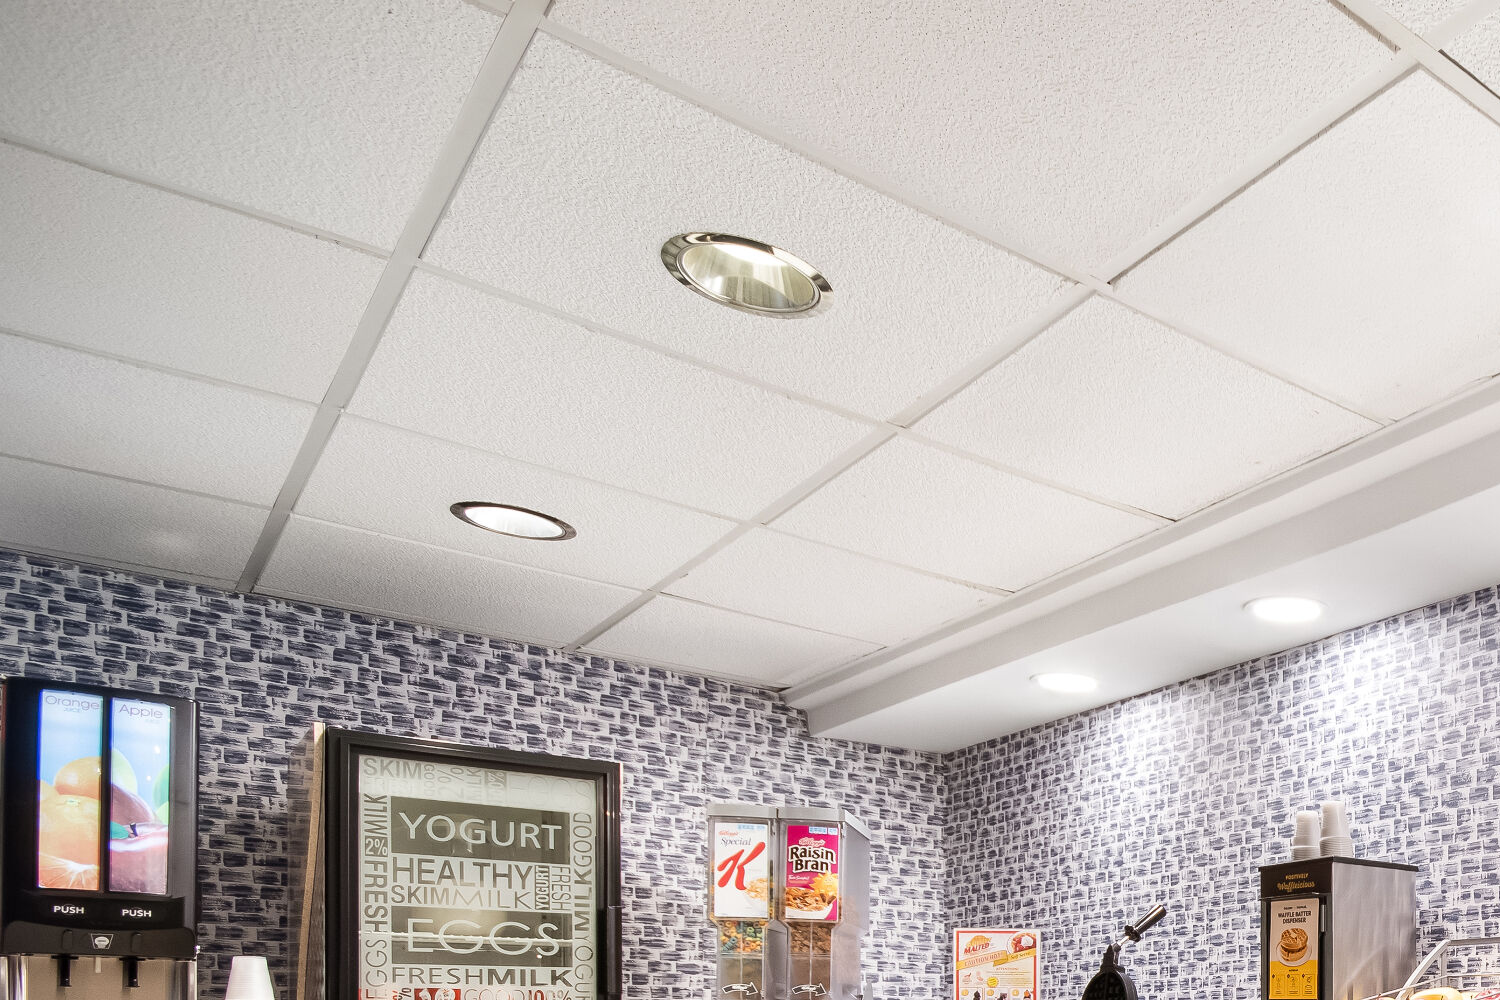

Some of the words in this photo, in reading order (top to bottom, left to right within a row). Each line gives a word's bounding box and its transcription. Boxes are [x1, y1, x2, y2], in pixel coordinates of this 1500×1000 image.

[45, 695, 100, 711] Orange
[120, 703, 163, 719] Apple
[363, 758, 422, 780] SKIM
[364, 793, 388, 835] MILK
[398, 812, 562, 850] YOGURT
[573, 812, 592, 867] GOOD
[721, 837, 752, 847] Special
[365, 837, 388, 856] 2%
[789, 846, 835, 861] Raisin
[392, 856, 533, 890] HEALTHY
[717, 841, 766, 891] K
[795, 860, 829, 872] Bran
[364, 860, 388, 933] FRESH
[535, 865, 550, 910] YOGURT
[552, 867, 571, 910] FRESH
[574, 868, 592, 931] MILK
[53, 905, 84, 914] PUSH
[122, 909, 152, 918] PUSH
[408, 918, 559, 956] EGGS
[964, 942, 990, 954] MALTED
[392, 966, 483, 985] FRESH
[488, 968, 573, 987] MILK
